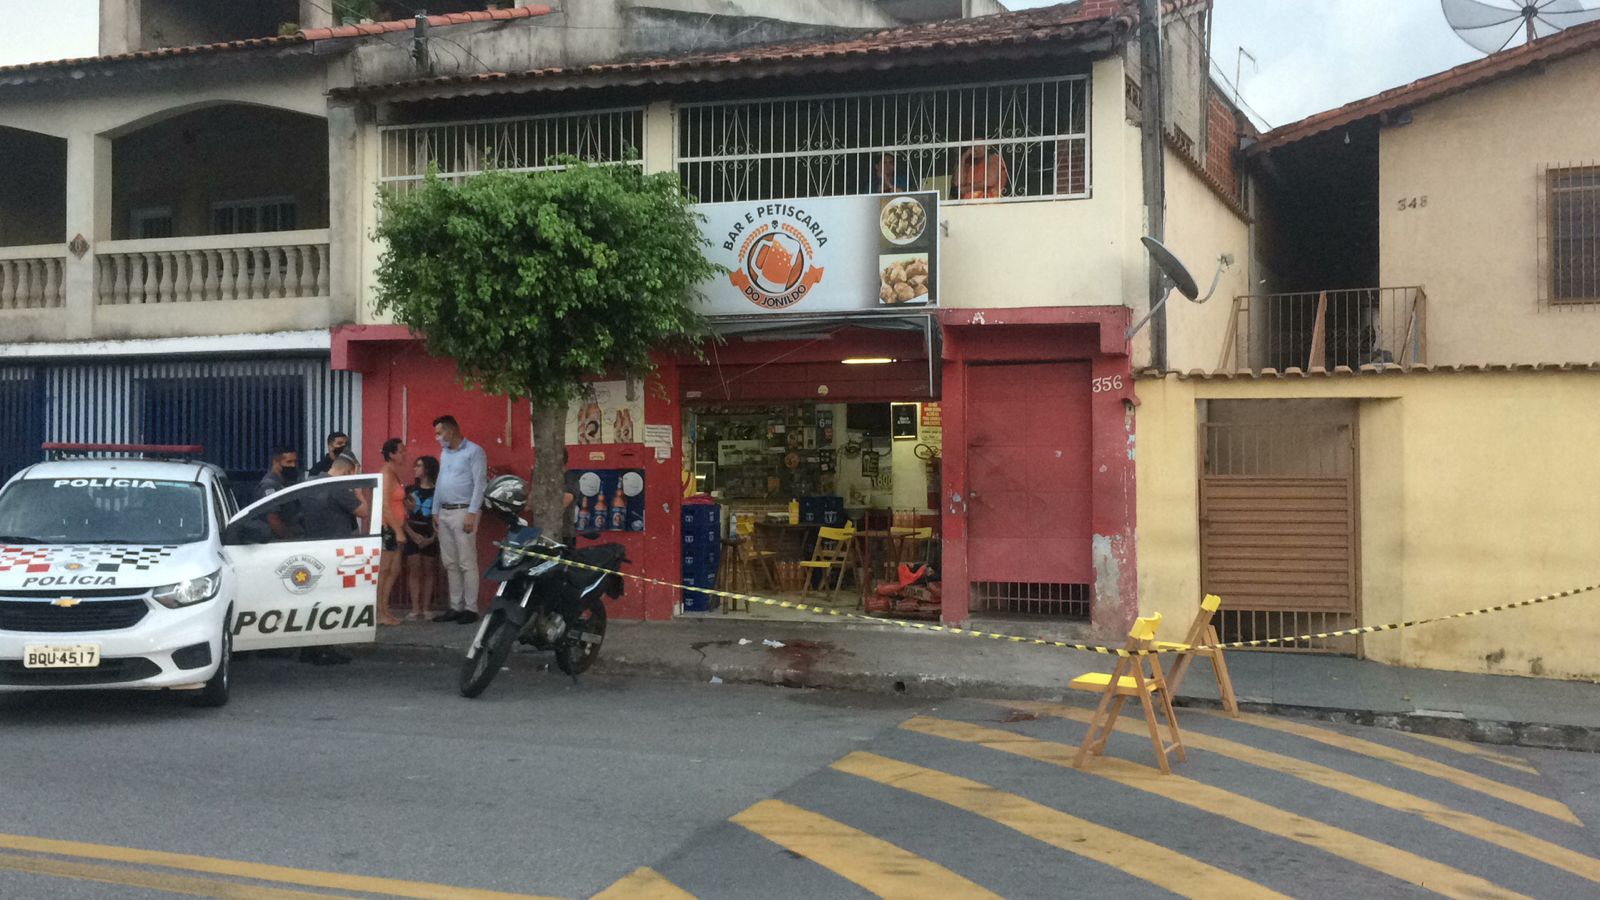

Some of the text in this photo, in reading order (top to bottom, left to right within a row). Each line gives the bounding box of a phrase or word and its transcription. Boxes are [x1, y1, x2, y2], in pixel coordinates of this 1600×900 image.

[723, 203, 828, 251] BAR E PETISCARIA
[744, 283, 807, 308] DO JONILDO
[1092, 375, 1123, 393] 356
[53, 477, 157, 490] POLÍCIA
[22, 574, 117, 588] POLÍCIA
[233, 601, 375, 636] POLÍCIA
